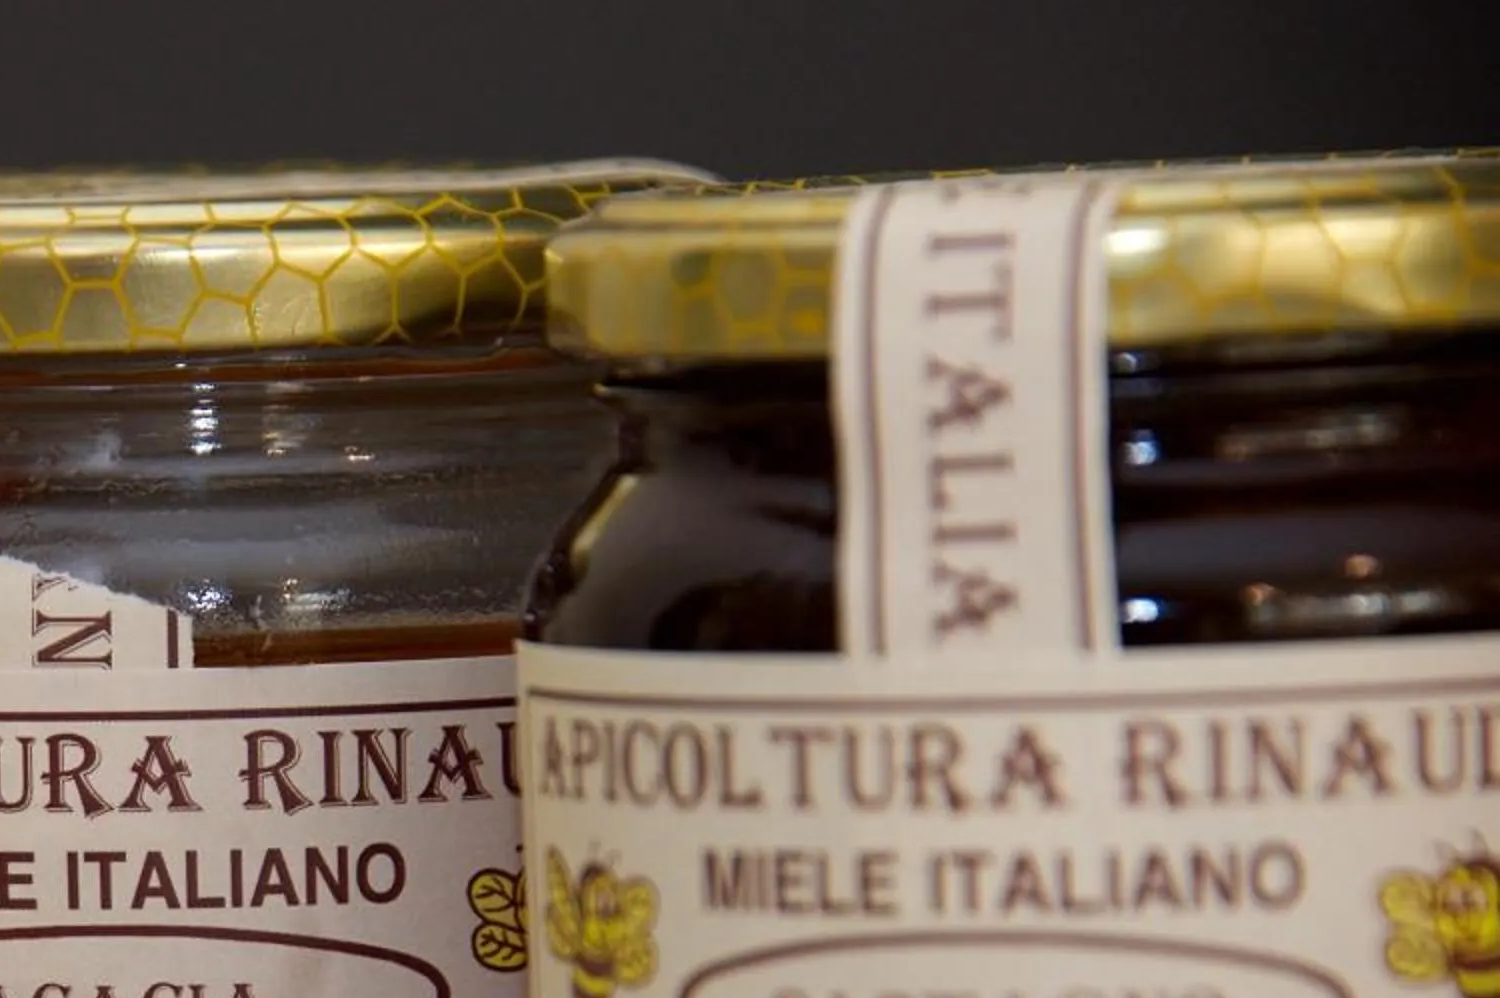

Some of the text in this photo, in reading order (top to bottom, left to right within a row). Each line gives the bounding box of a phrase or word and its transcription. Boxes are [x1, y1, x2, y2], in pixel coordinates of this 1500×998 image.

[31, 573, 114, 670] N
[538, 715, 1065, 814] APICOLTURA
[66, 842, 406, 911] ITALIANO
[703, 840, 1307, 917] MIELE ITALIANO
